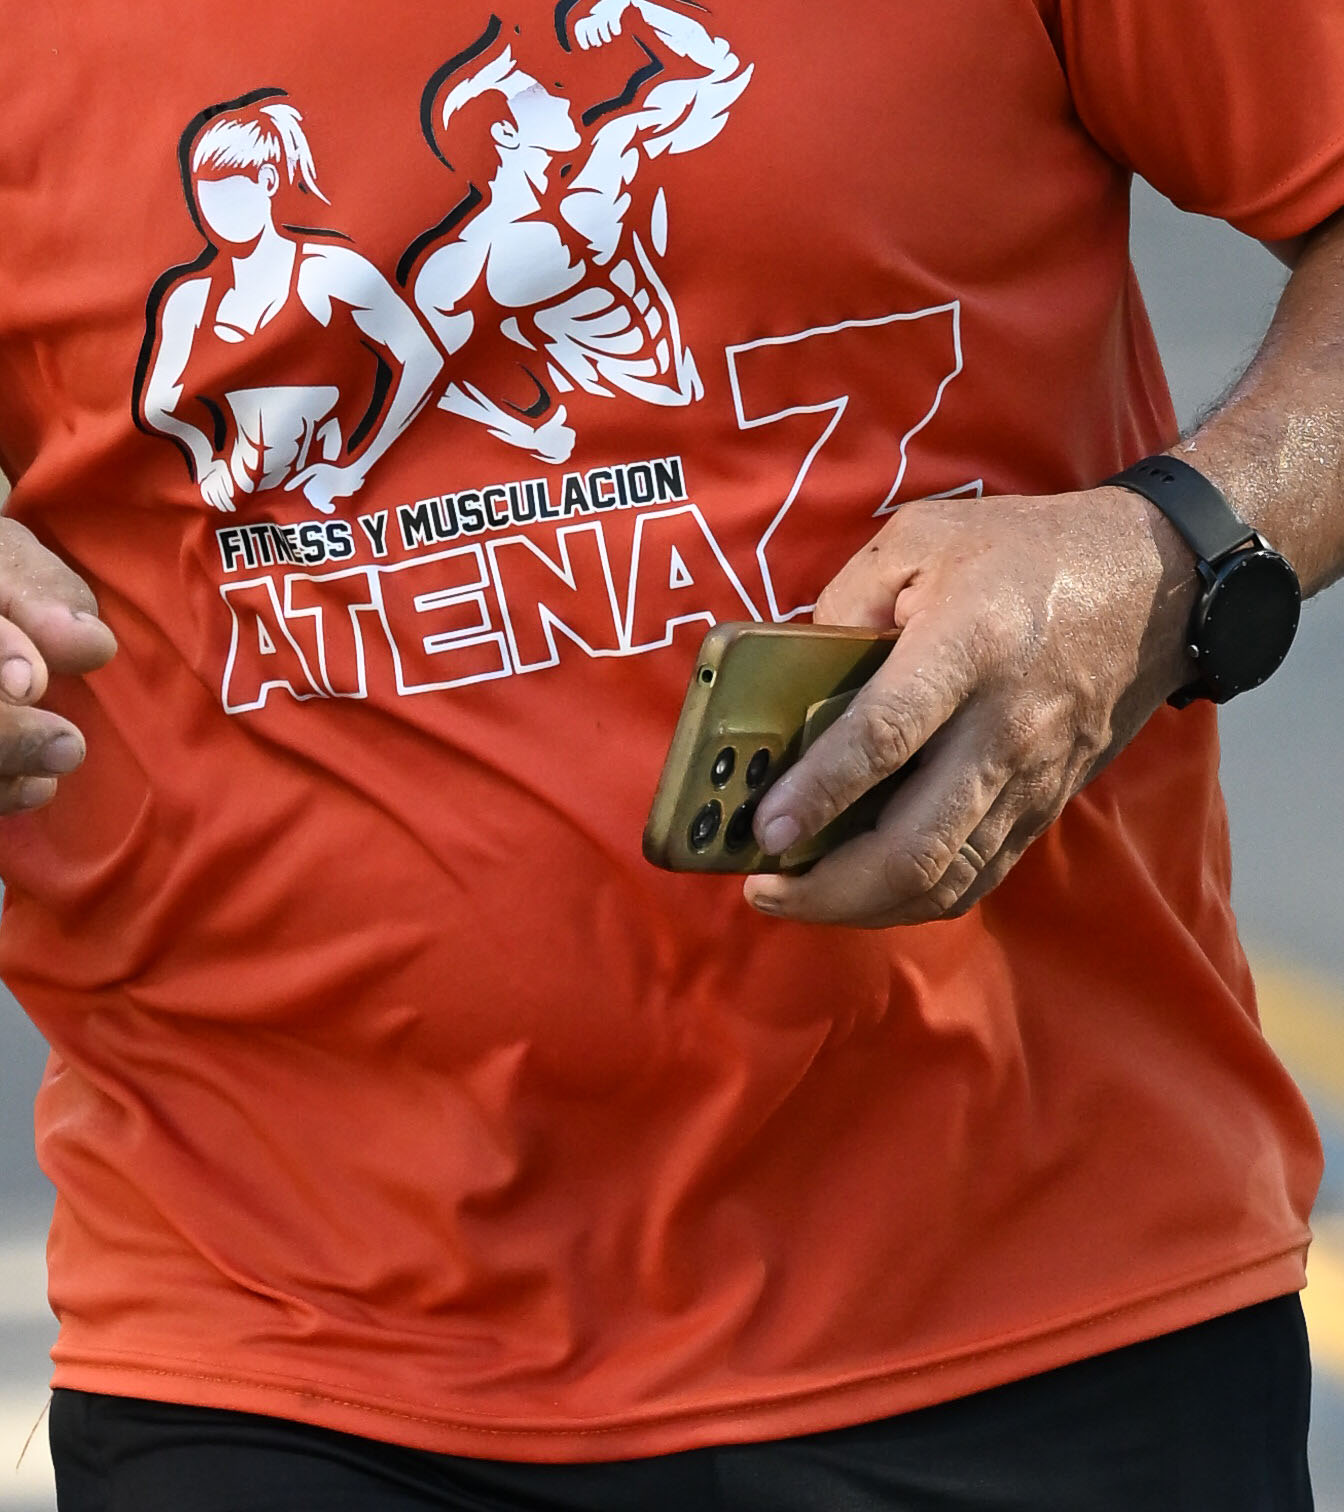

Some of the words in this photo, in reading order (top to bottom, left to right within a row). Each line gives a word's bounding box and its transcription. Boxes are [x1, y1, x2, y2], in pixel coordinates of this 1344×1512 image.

[216, 521, 355, 573] FITNESS
[359, 513, 389, 558] Y
[397, 456, 689, 550] MUSCULACION
